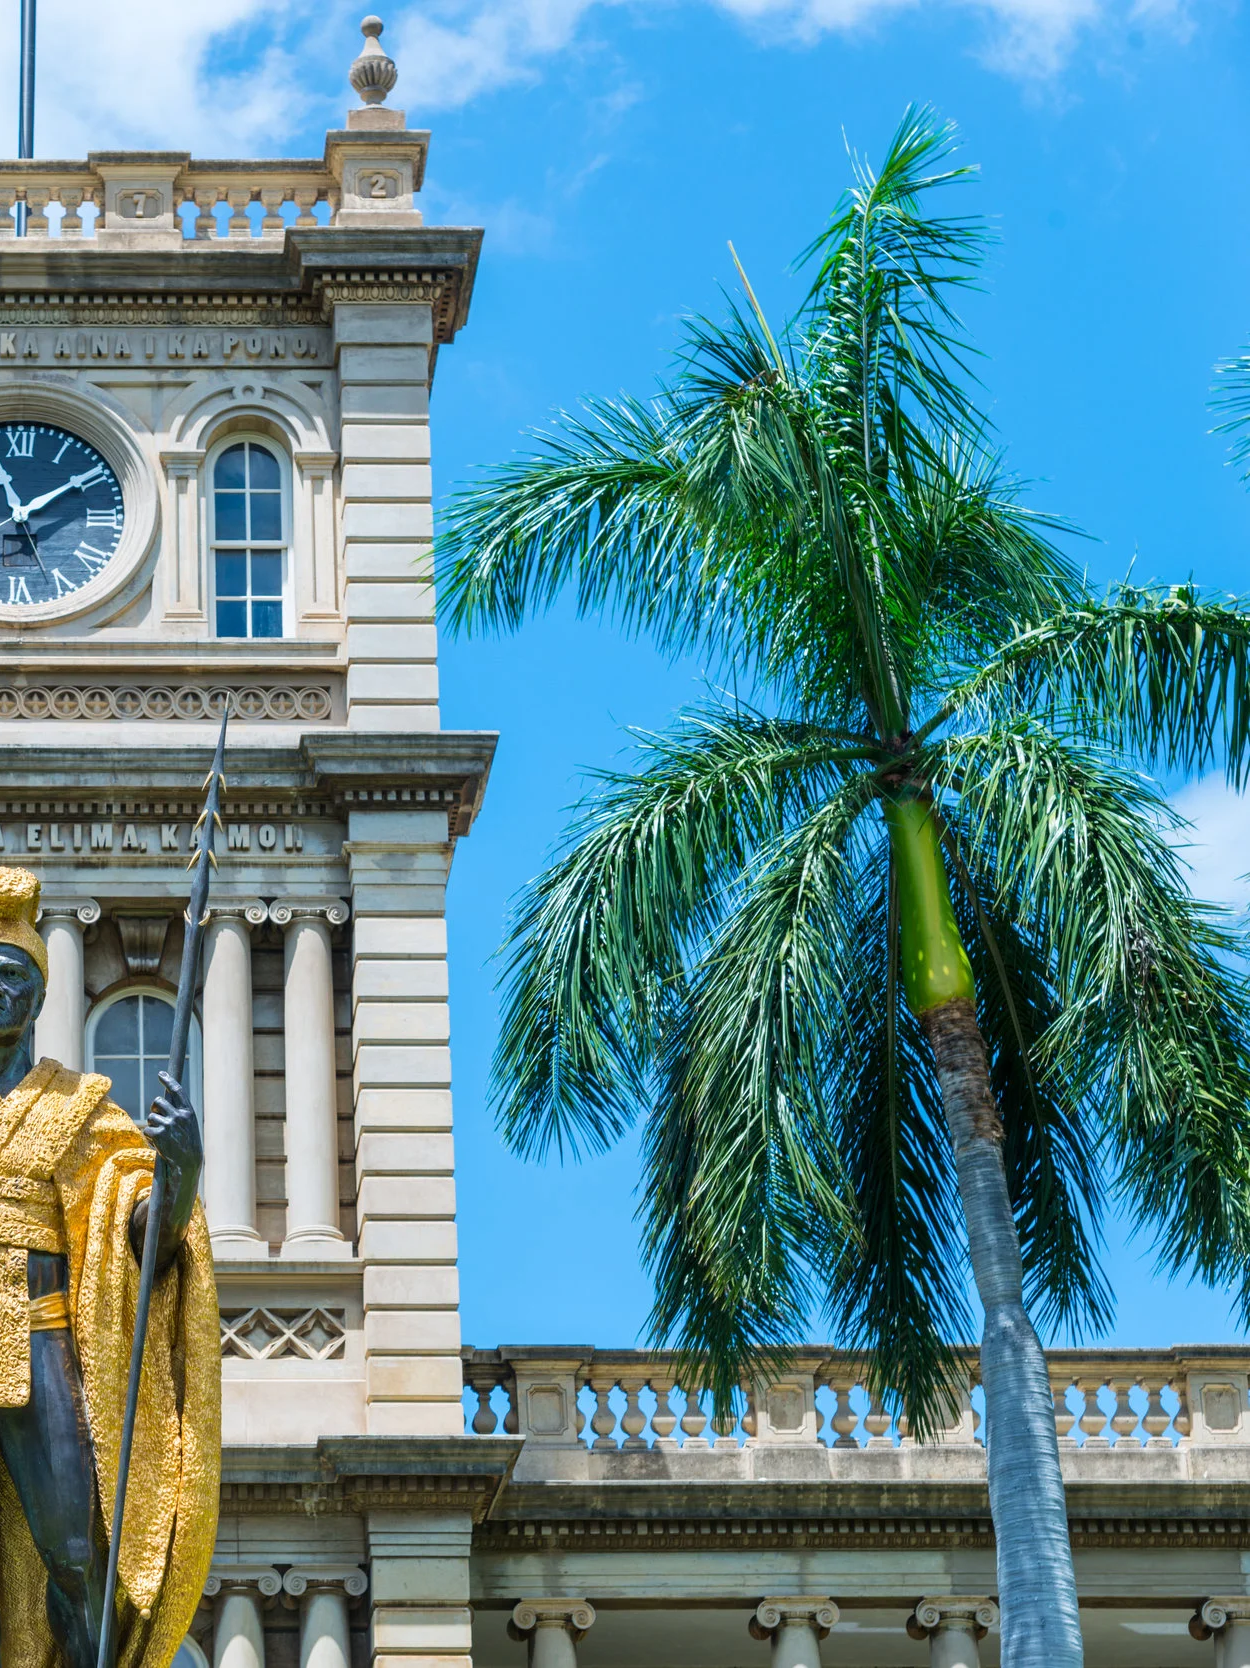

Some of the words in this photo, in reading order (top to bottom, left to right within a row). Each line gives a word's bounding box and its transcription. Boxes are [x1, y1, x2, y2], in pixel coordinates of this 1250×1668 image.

[132, 193, 145, 218] 7
[371, 173, 387, 199] 2
[0, 332, 40, 358] KA
[54, 333, 132, 359] AINA
[168, 333, 209, 359] KA
[222, 332, 318, 359] PONO.
[6, 431, 36, 458] XII
[27, 823, 148, 850] ELIMA,
